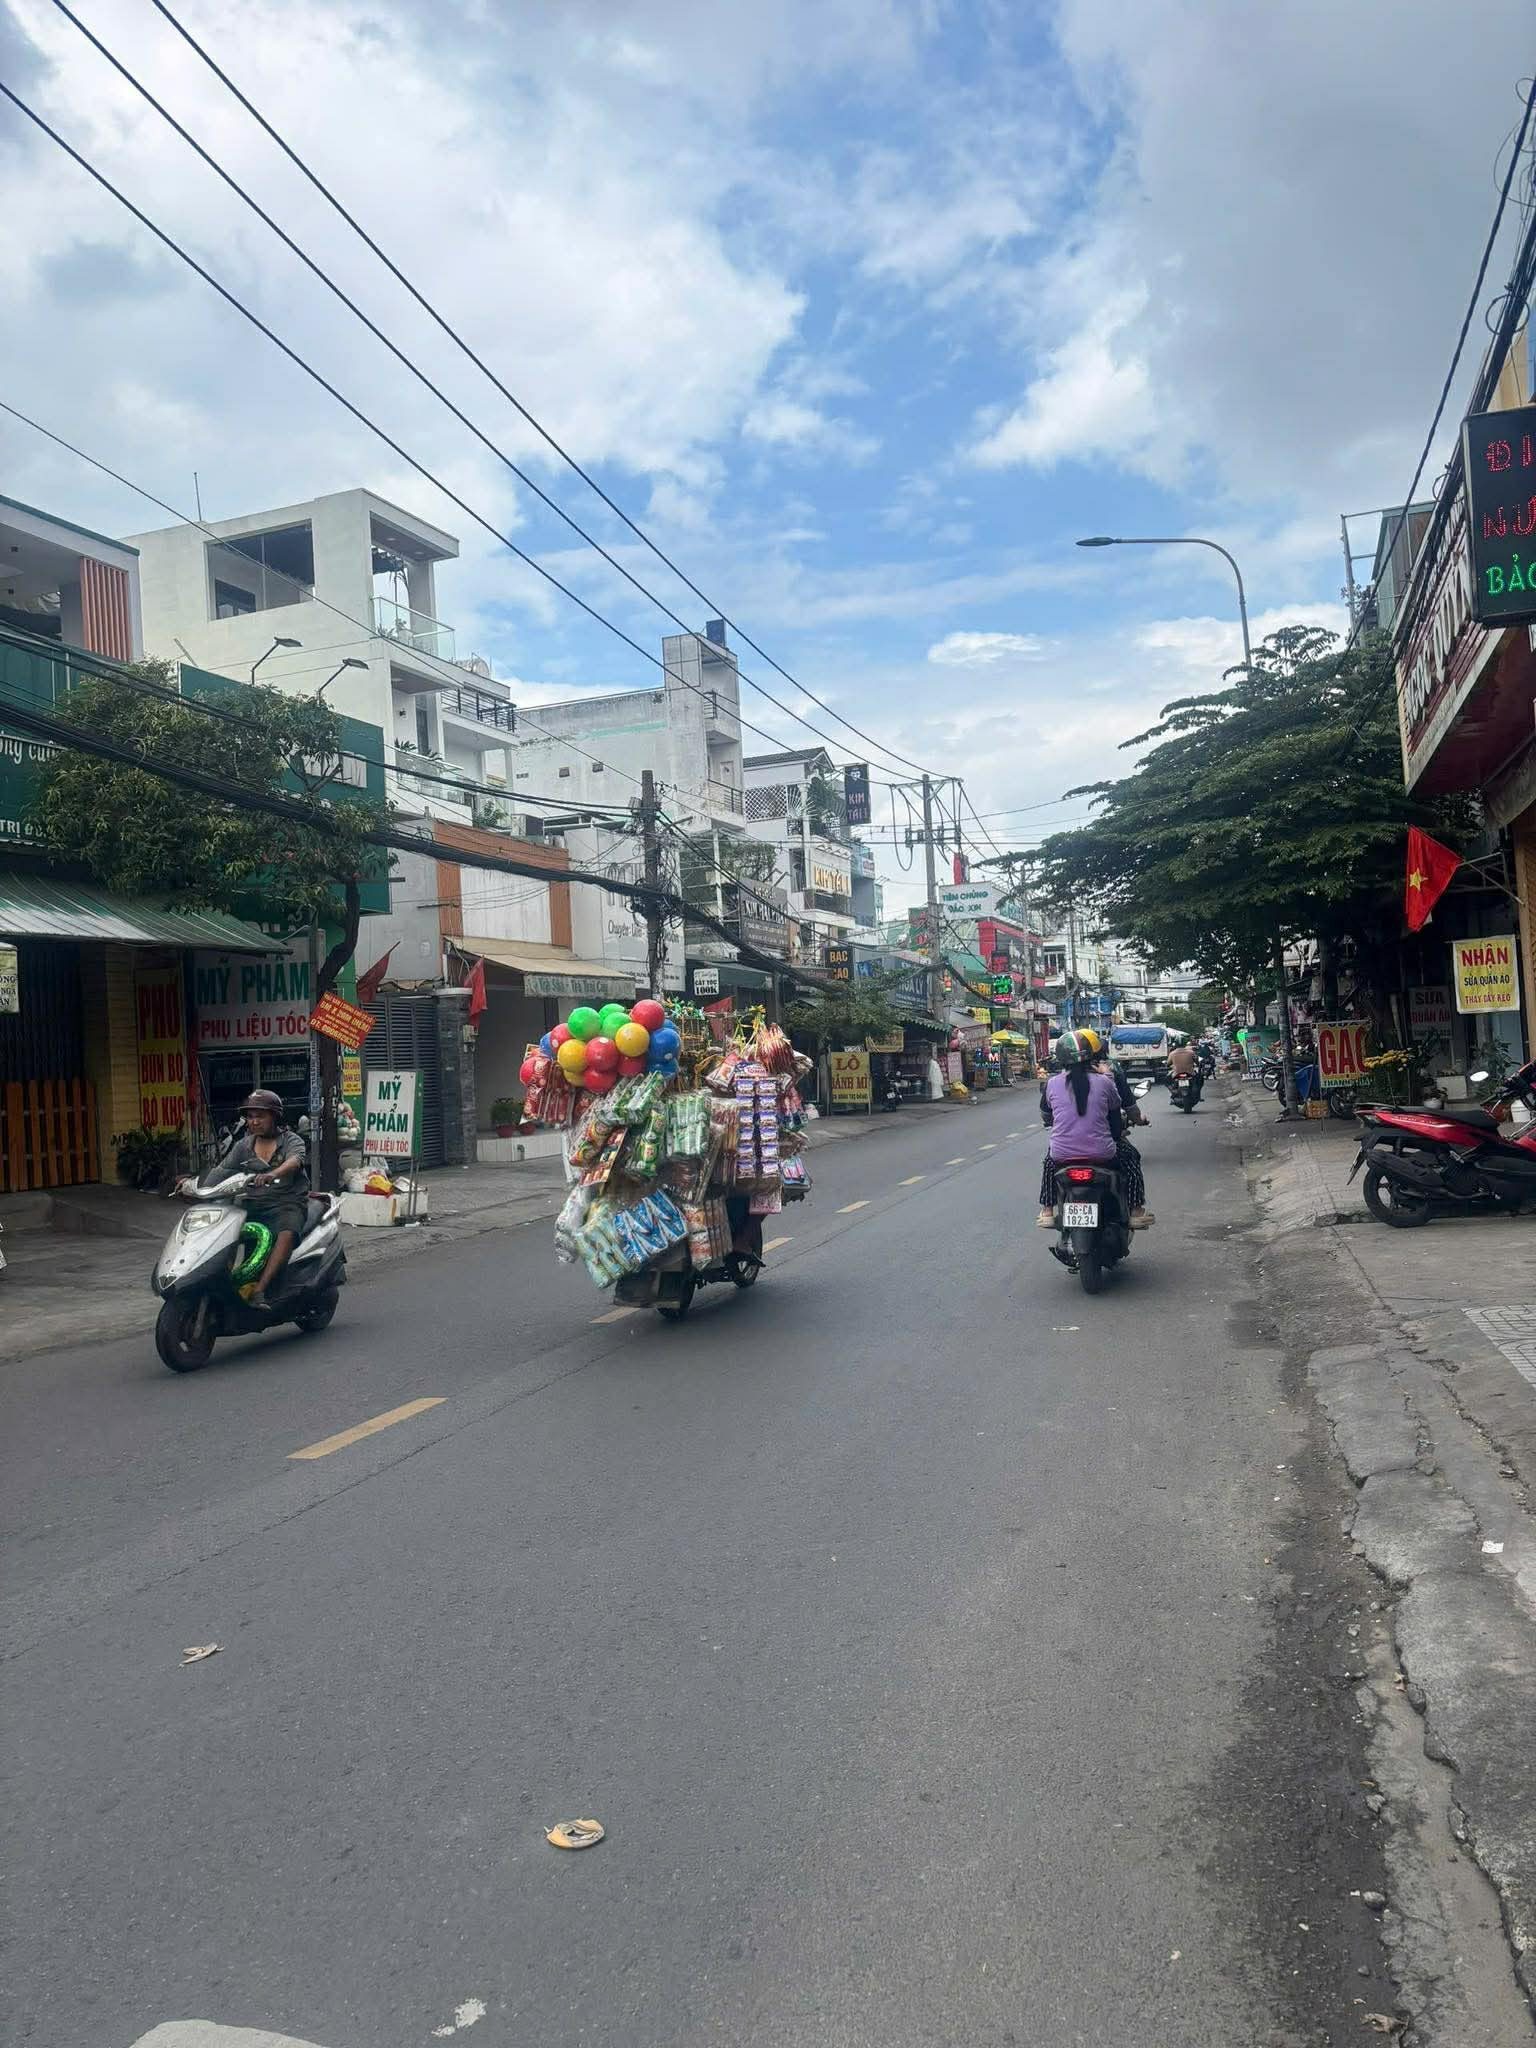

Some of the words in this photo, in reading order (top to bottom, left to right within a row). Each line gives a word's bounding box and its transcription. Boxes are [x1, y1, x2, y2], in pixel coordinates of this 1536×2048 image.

[1461, 943, 1509, 969] NHẬN
[196, 956, 231, 1005] MỸ
[1465, 994, 1482, 1004] THAY
[200, 1019, 231, 1042] PHỤ
[236, 1012, 271, 1040] LIỆU
[275, 1010, 307, 1036] TÓC
[378, 1074, 402, 1100] MỸ
[367, 1103, 409, 1132] PHẨM
